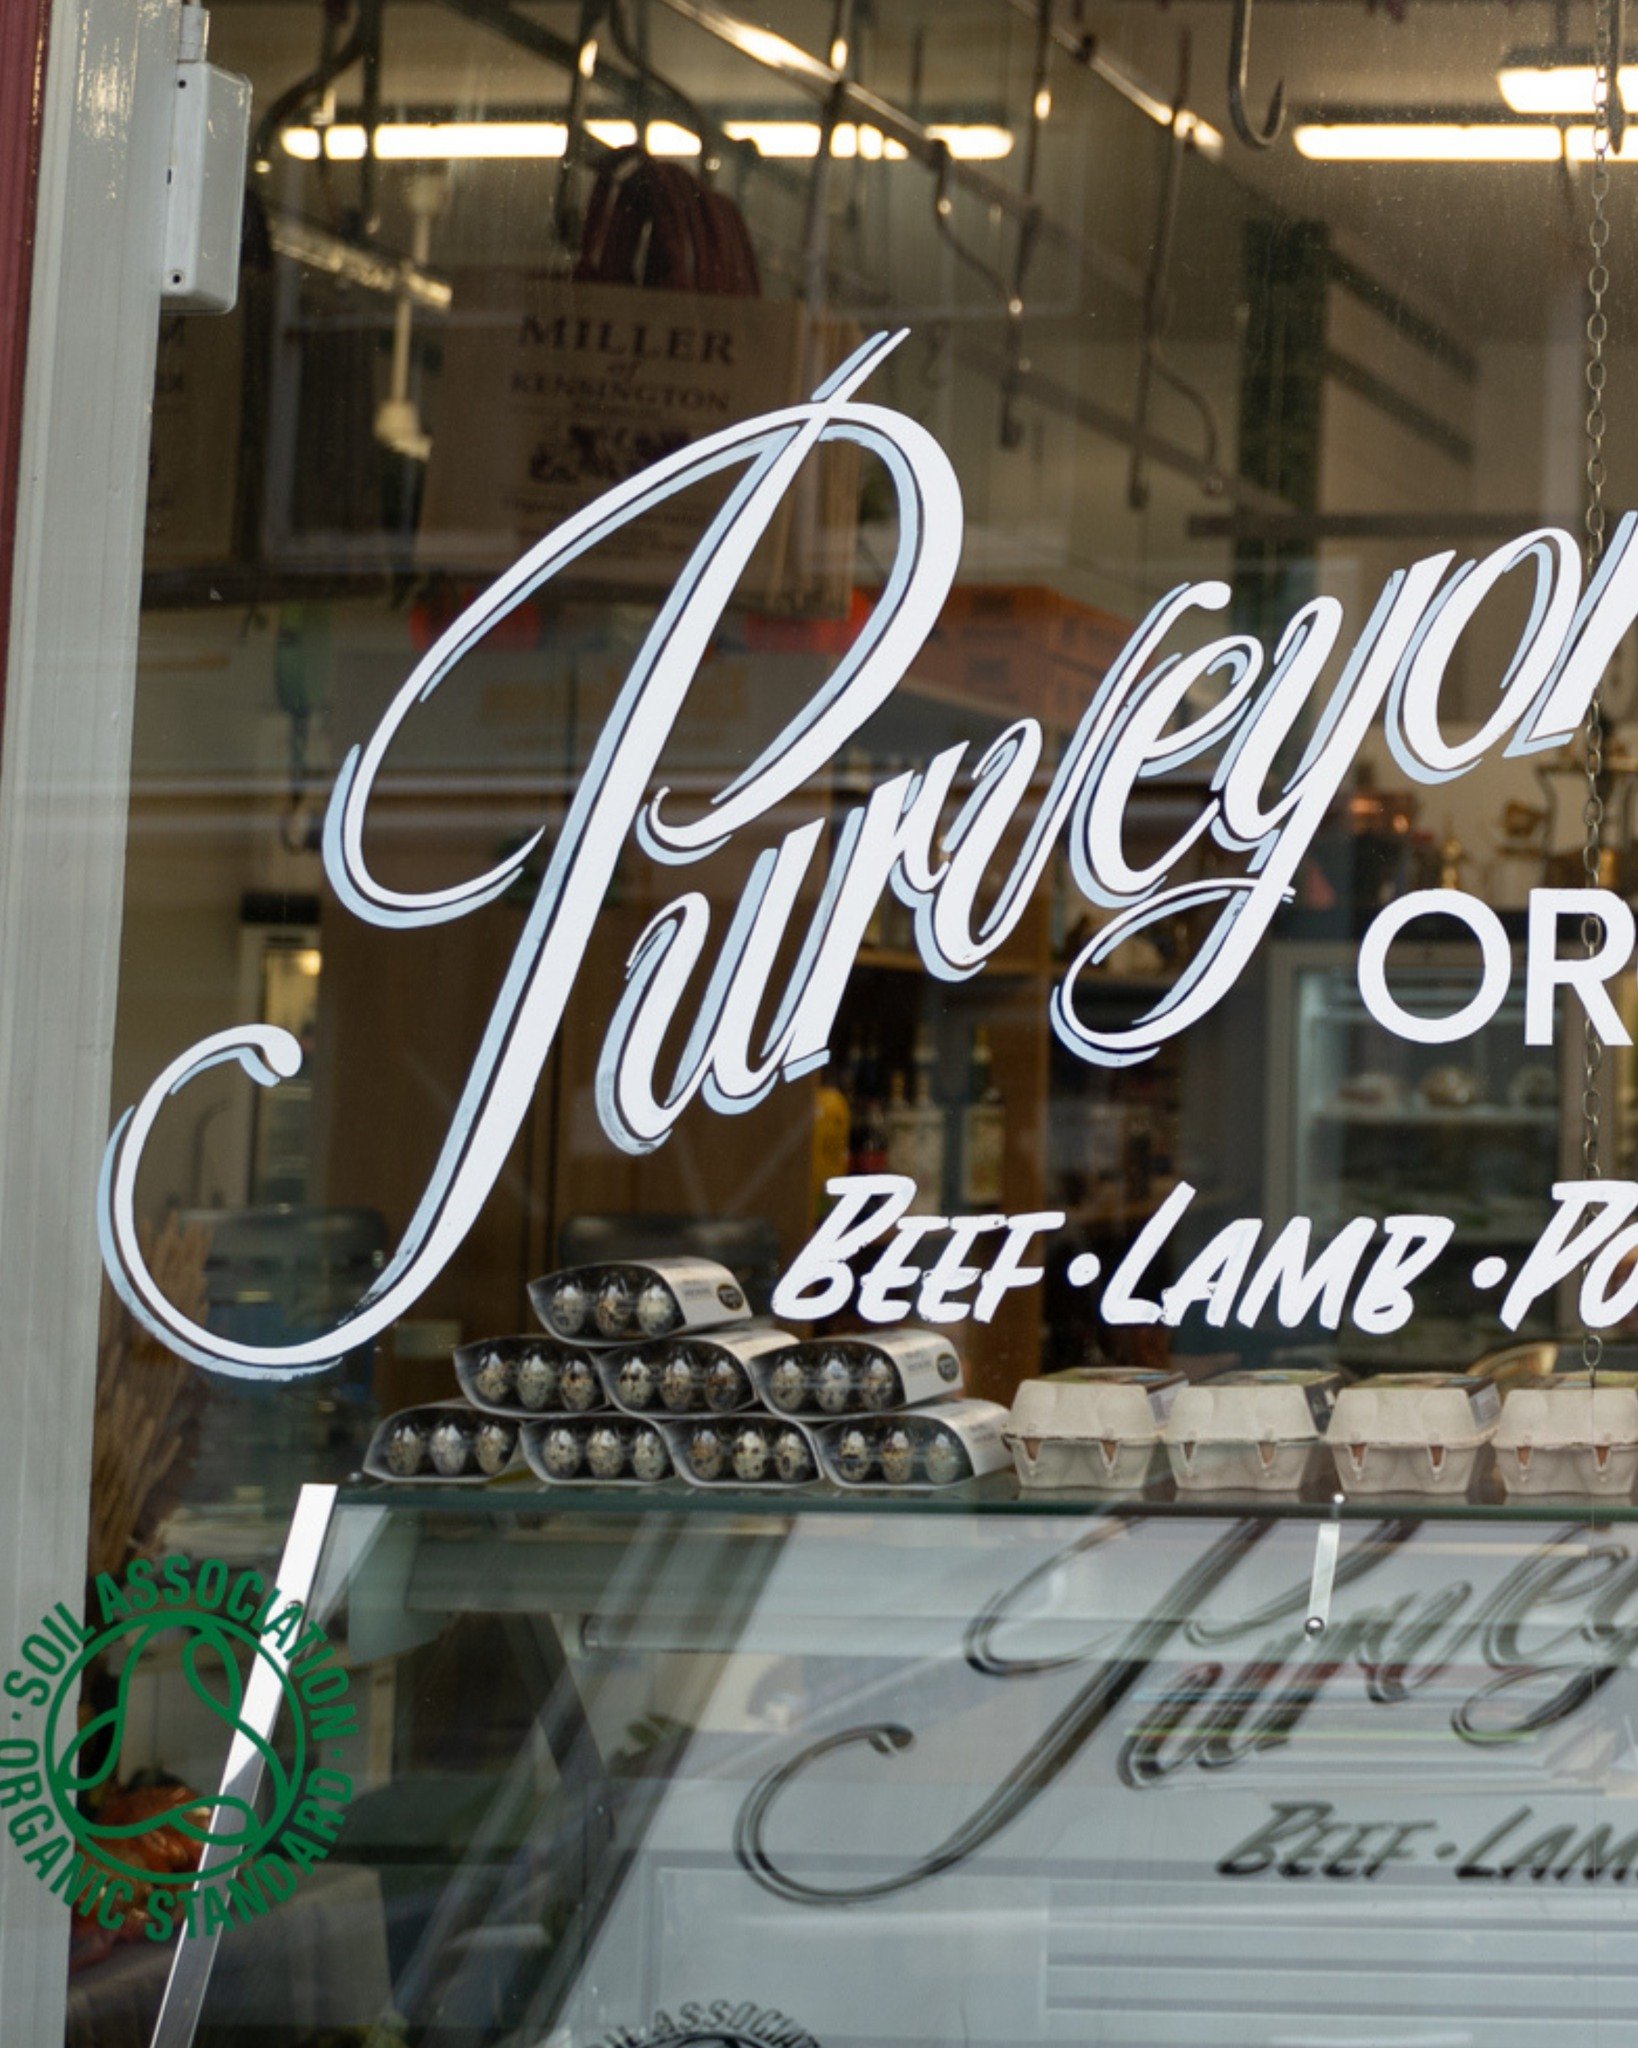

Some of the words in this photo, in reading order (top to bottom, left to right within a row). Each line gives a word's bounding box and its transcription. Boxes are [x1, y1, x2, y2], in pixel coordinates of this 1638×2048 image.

[519, 314, 735, 365] MILLER
[771, 1174, 1066, 1324] BEEF
[1100, 1181, 1455, 1334] LAMB
[1500, 1180, 1638, 1331] PO
[3, 1602, 97, 1709] SOIL
[94, 1554, 359, 1741] ASSOCIATION
[0, 1737, 134, 1931] ORGANIC
[144, 1767, 354, 1942] STANDARD
[1215, 1801, 1438, 1878] BEEF
